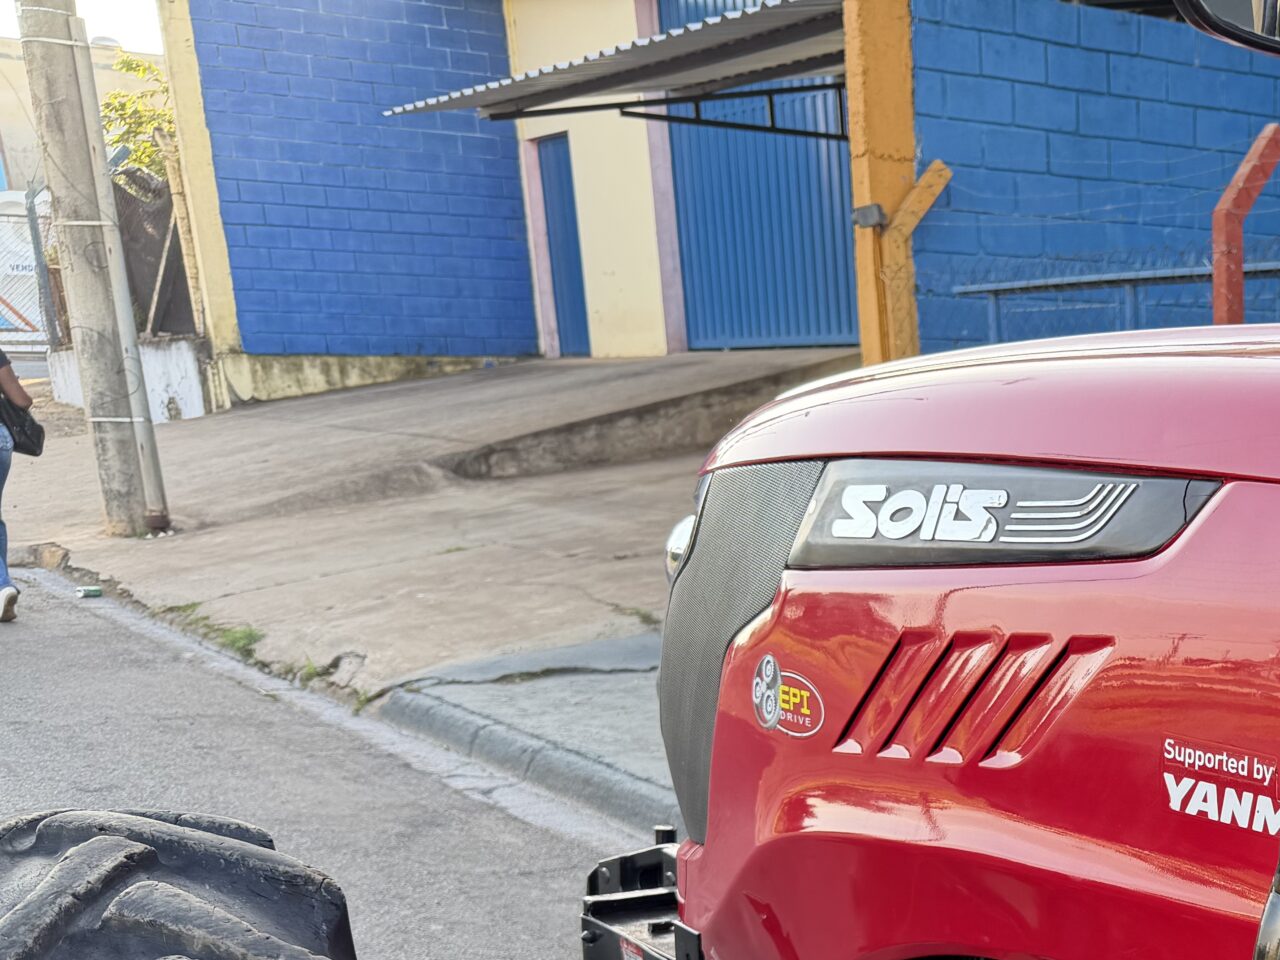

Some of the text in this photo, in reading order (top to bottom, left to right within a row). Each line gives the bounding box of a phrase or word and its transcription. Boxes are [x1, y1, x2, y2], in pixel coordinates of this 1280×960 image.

[780, 710, 812, 727] DRIVE
[1164, 738, 1277, 786] Supported by
